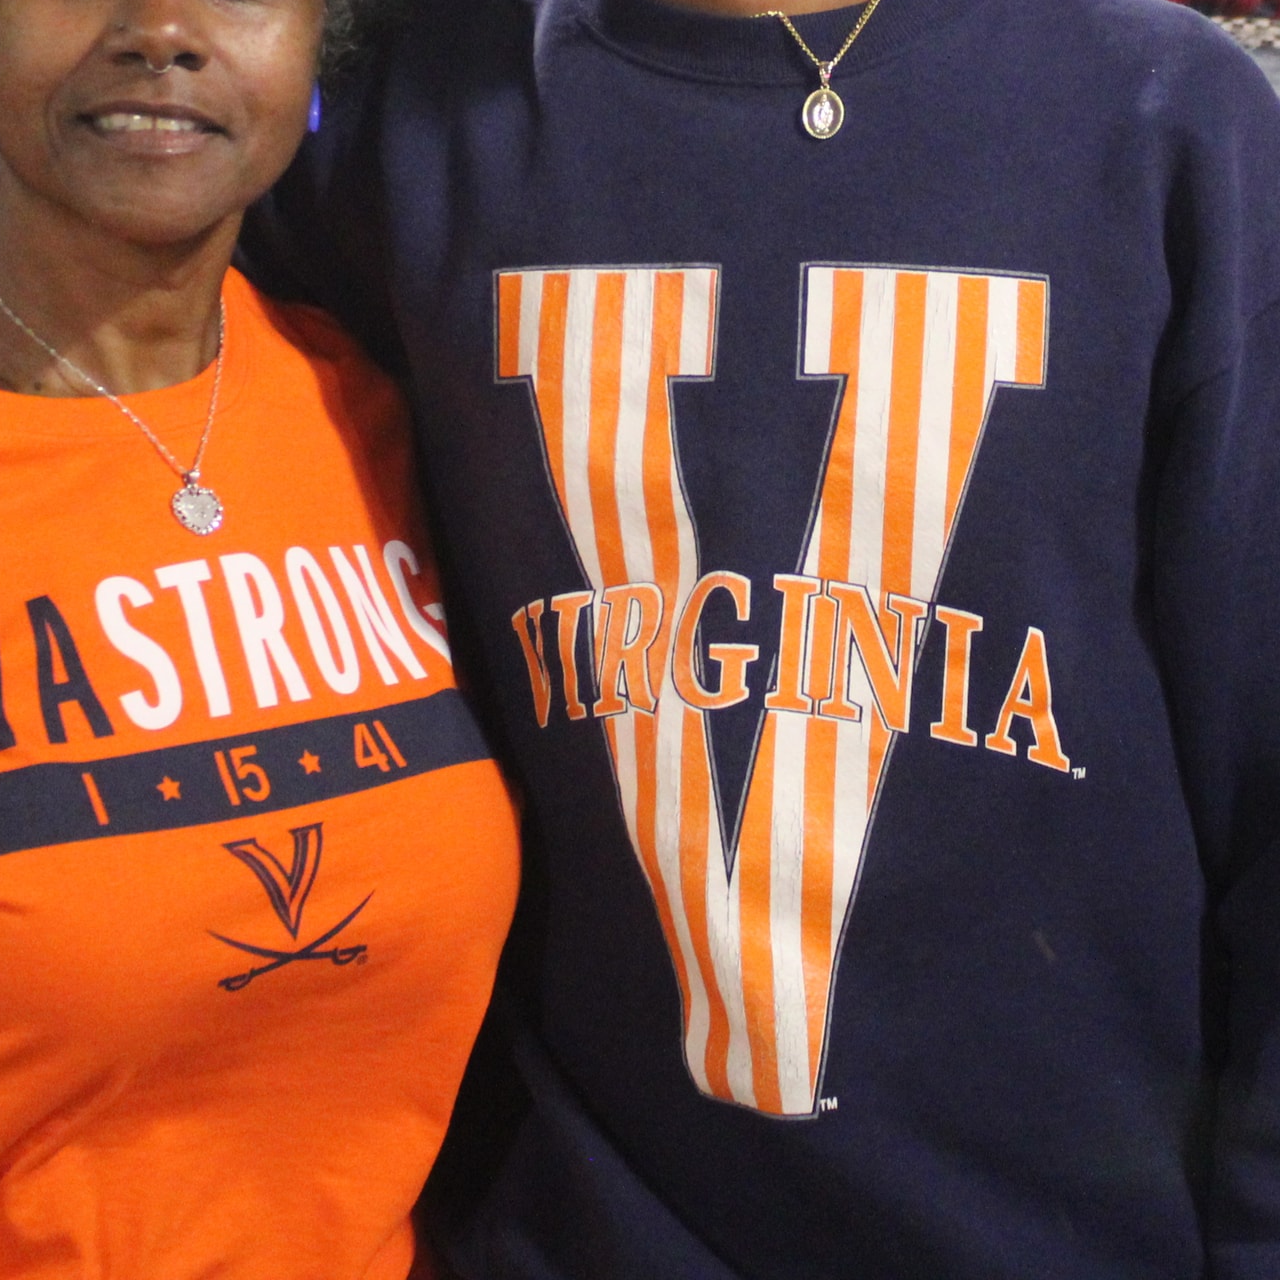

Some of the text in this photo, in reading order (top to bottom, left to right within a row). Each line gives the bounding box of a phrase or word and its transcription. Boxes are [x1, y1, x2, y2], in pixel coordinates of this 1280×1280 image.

[511, 571, 1071, 774] VIRGINIA
[214, 745, 271, 807] 15
[353, 720, 408, 773] 41
